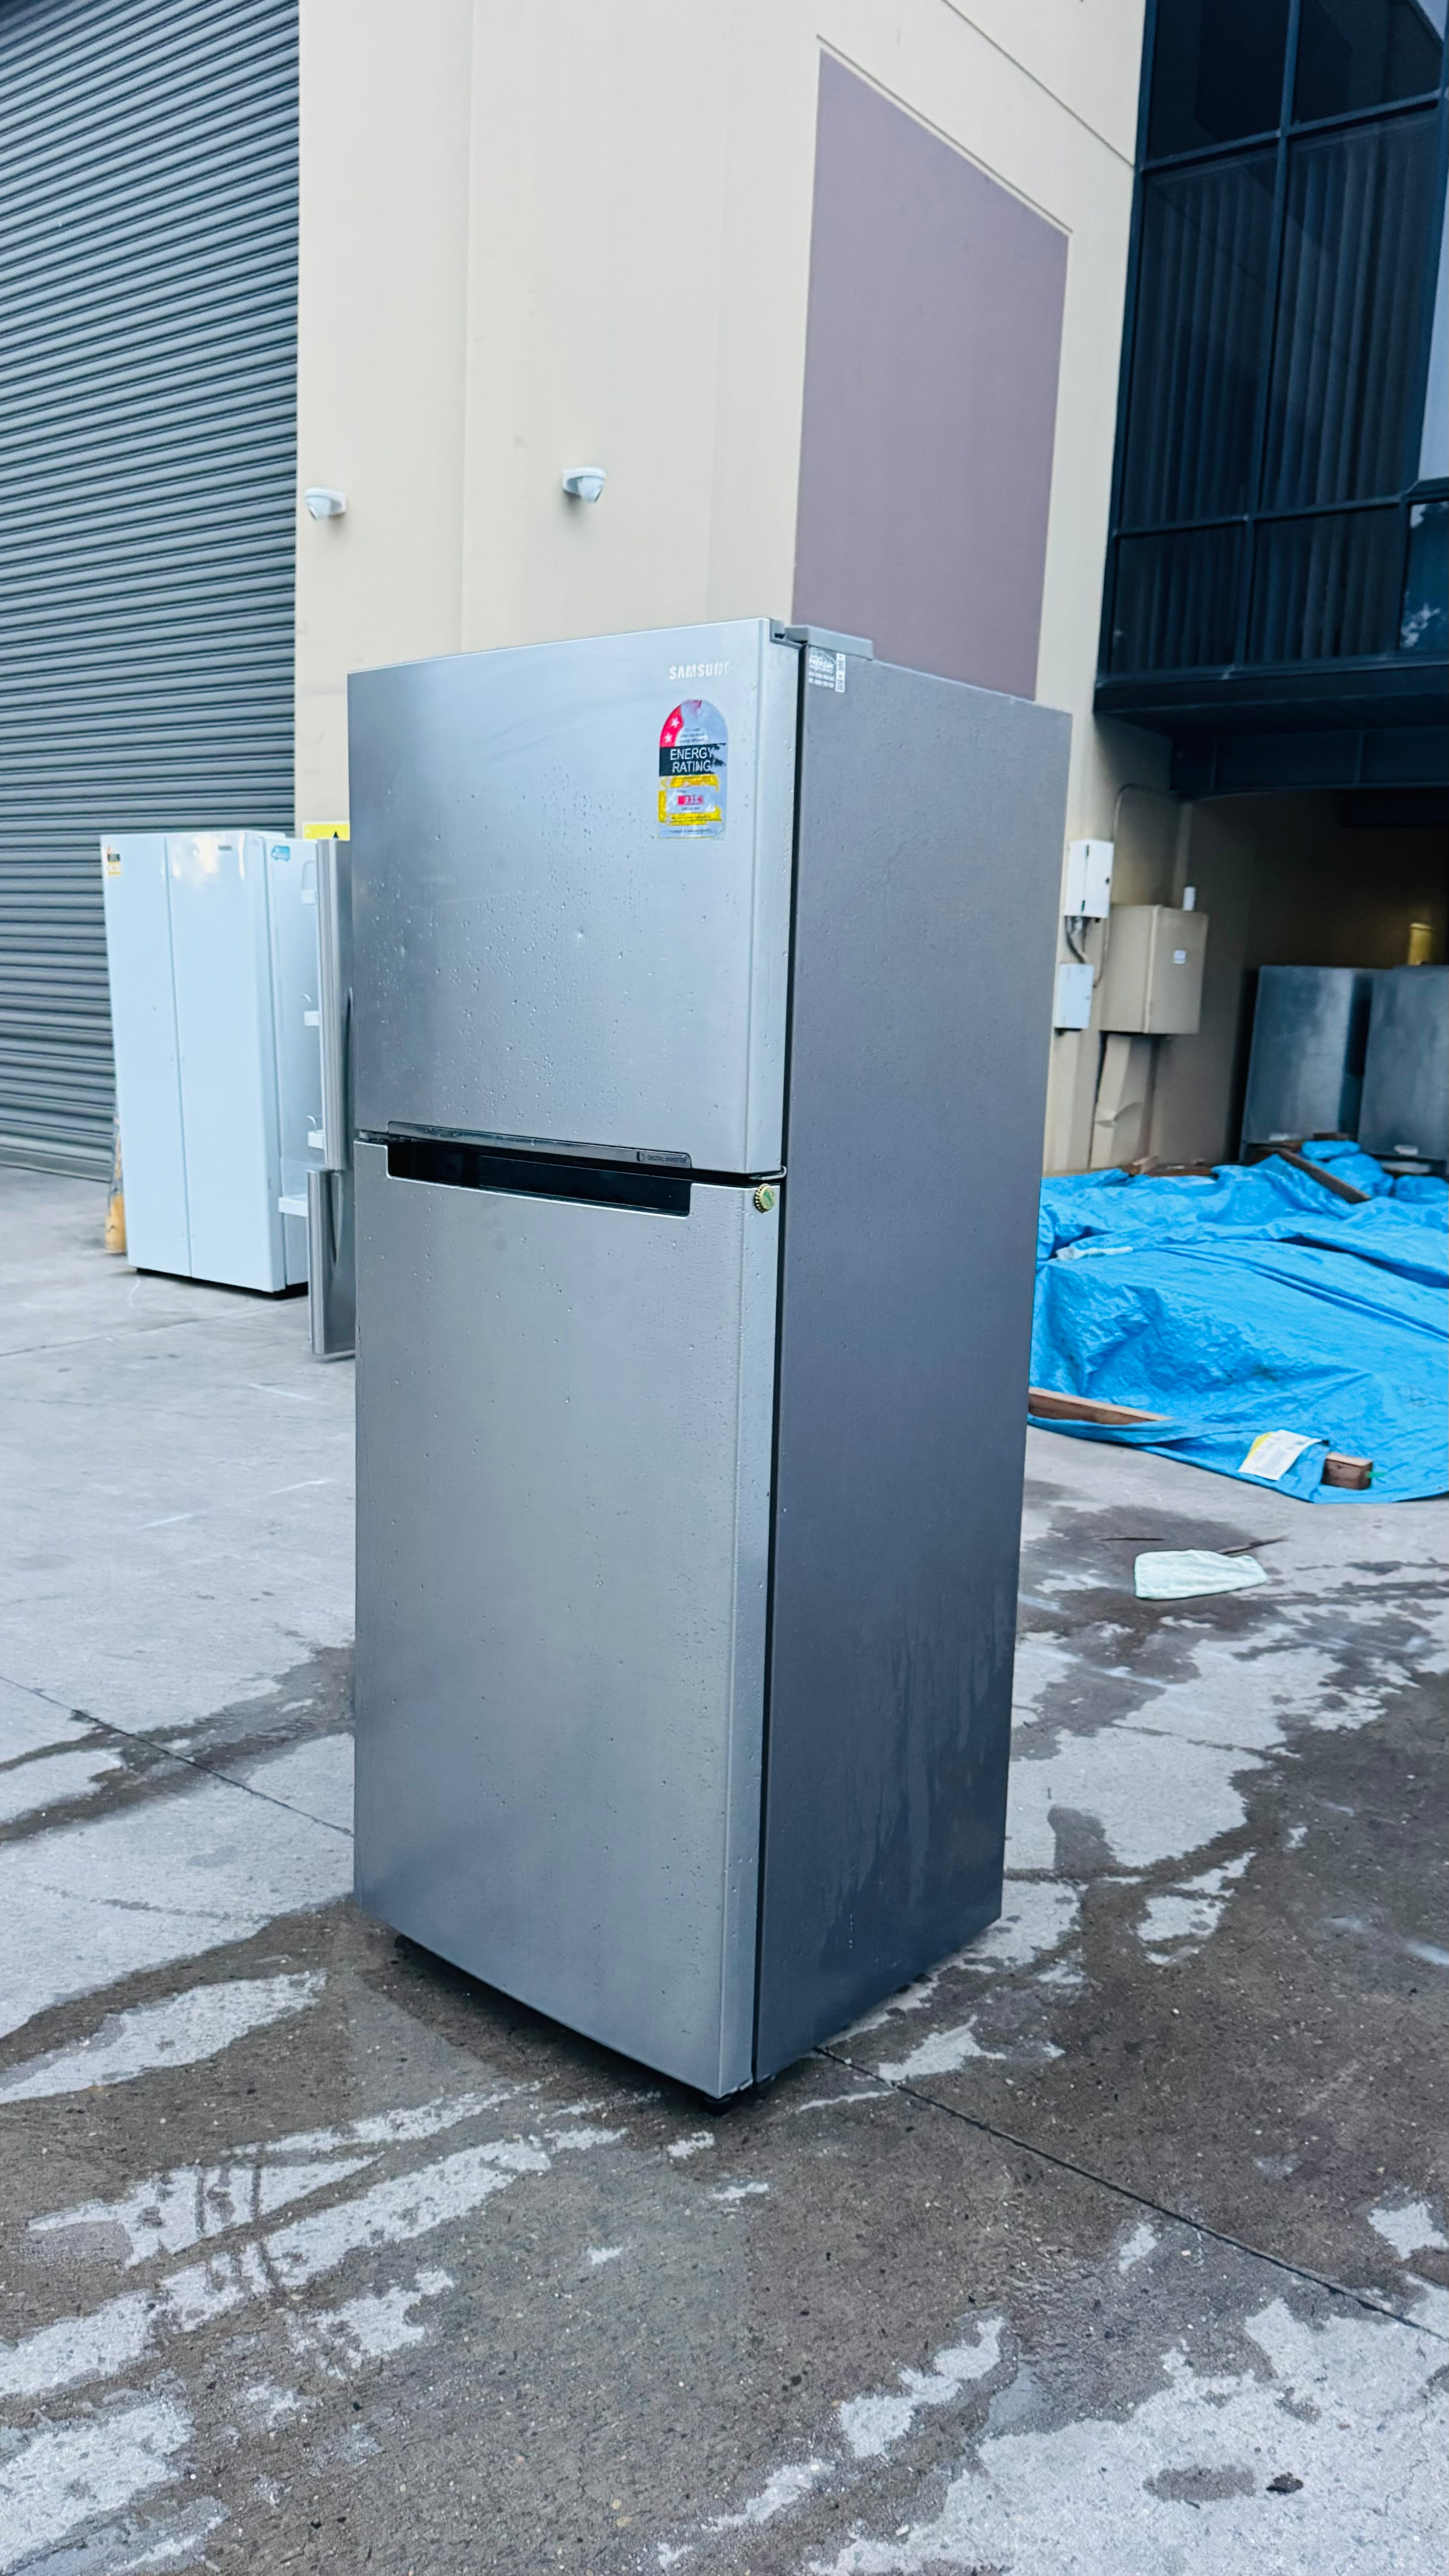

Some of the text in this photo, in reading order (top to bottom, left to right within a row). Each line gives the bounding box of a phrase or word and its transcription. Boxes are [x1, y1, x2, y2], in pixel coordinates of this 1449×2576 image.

[669, 661, 732, 680] SAMSUNG
[670, 747, 714, 761] ENERGY
[672, 759, 711, 773] RATING
